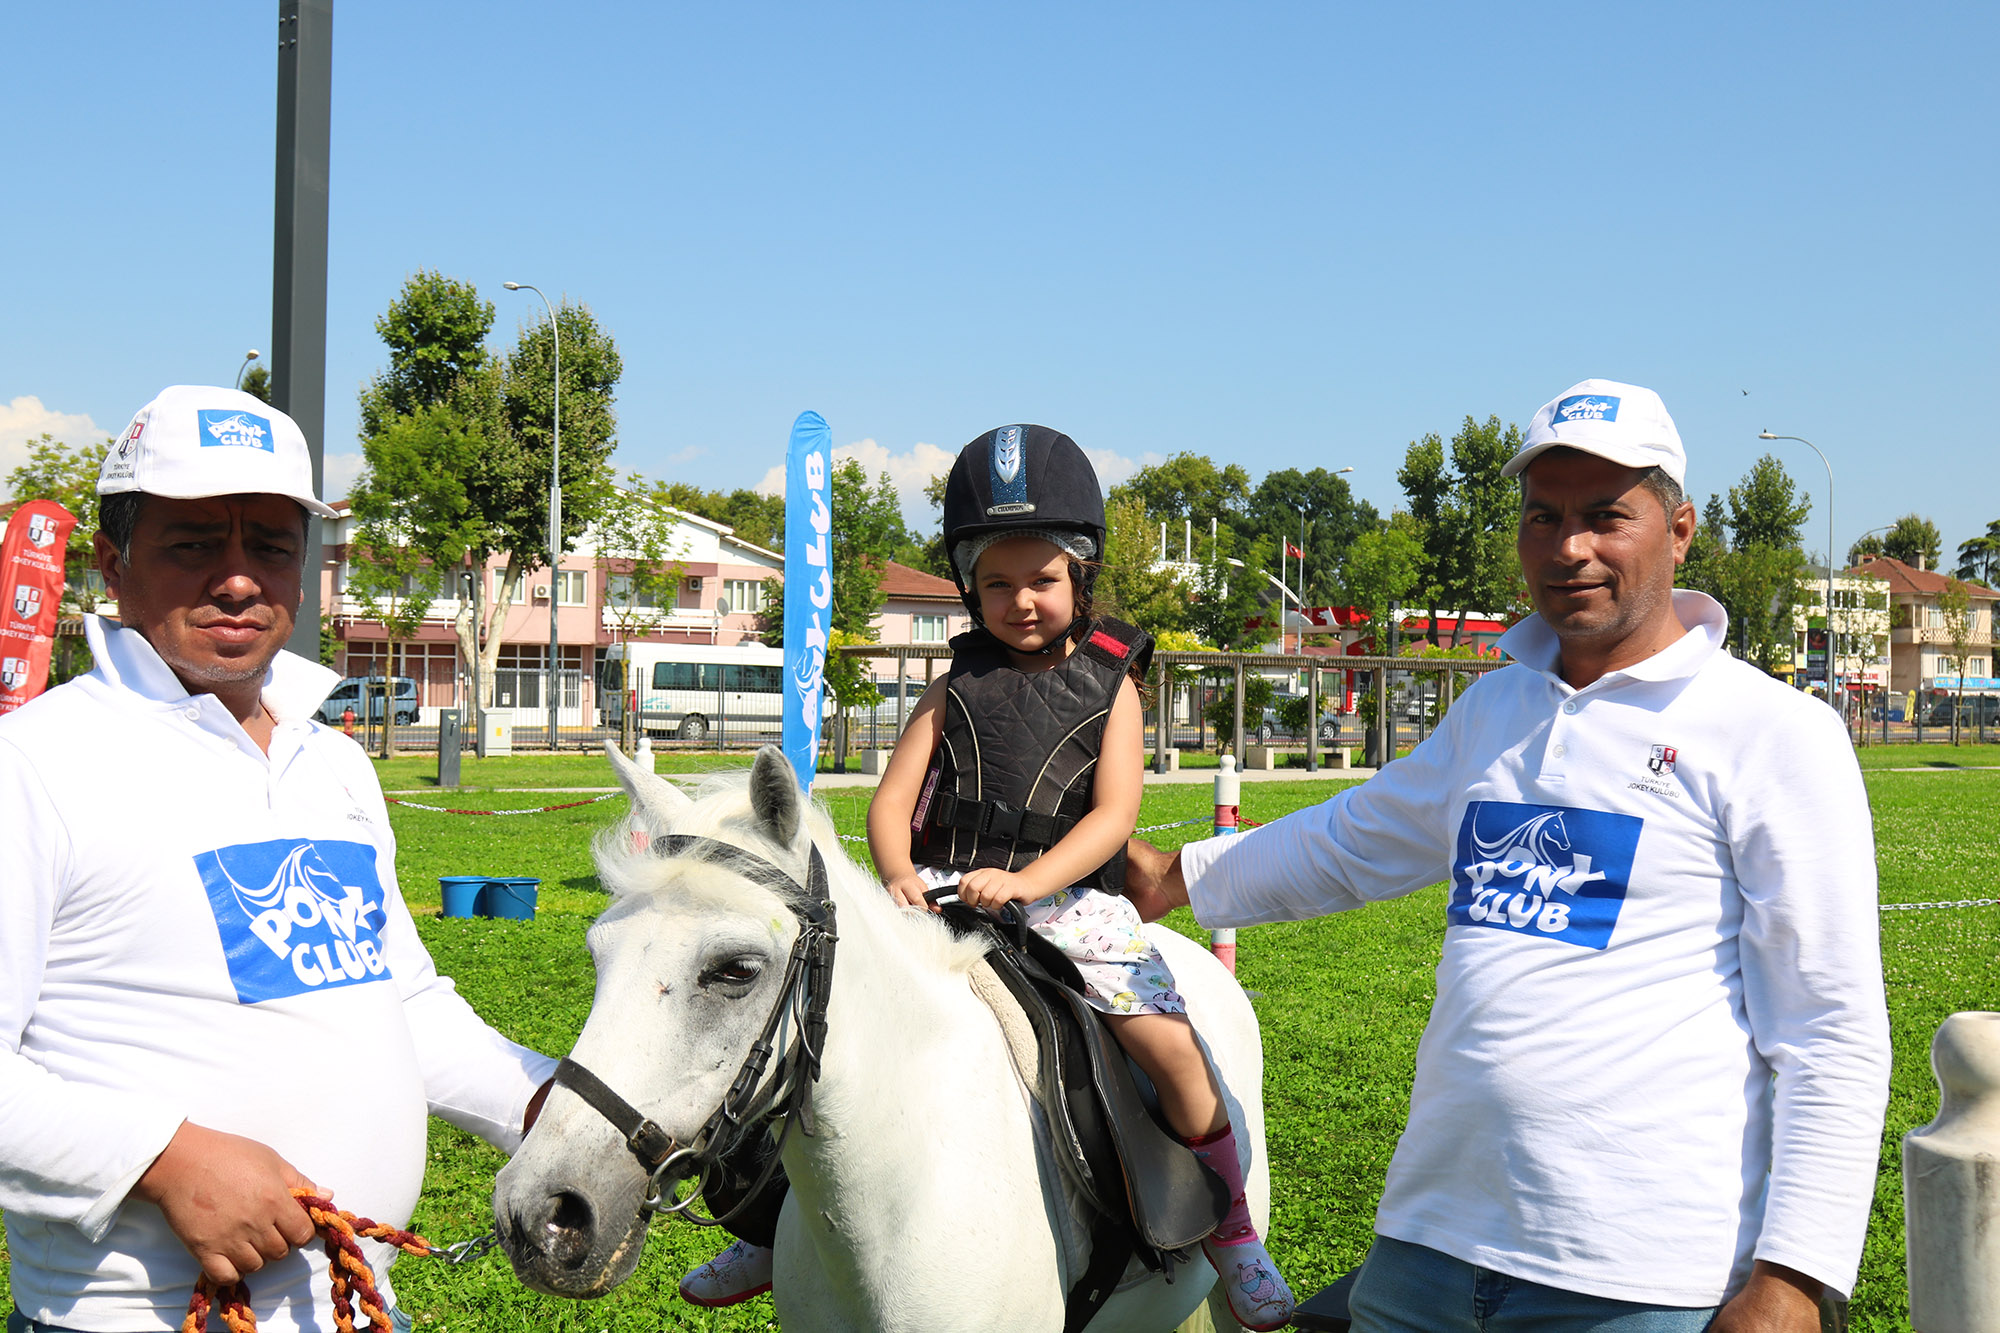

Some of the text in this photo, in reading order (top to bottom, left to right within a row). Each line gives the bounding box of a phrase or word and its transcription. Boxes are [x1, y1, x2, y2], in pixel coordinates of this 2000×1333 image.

[1560, 402, 1613, 418] PONY
[1567, 411, 1604, 420] CLUB
[207, 423, 267, 440] PONY
[220, 434, 264, 448] CLUB
[805, 451, 831, 610] CLUB
[1627, 783, 1680, 799] JOKEY KULÜBÜ
[1640, 776, 1671, 789] TÜRKİYE
[1464, 846, 1607, 901] PONY
[1468, 888, 1571, 933] CLUB
[248, 885, 378, 961] PONY
[291, 939, 386, 987] CLUB
